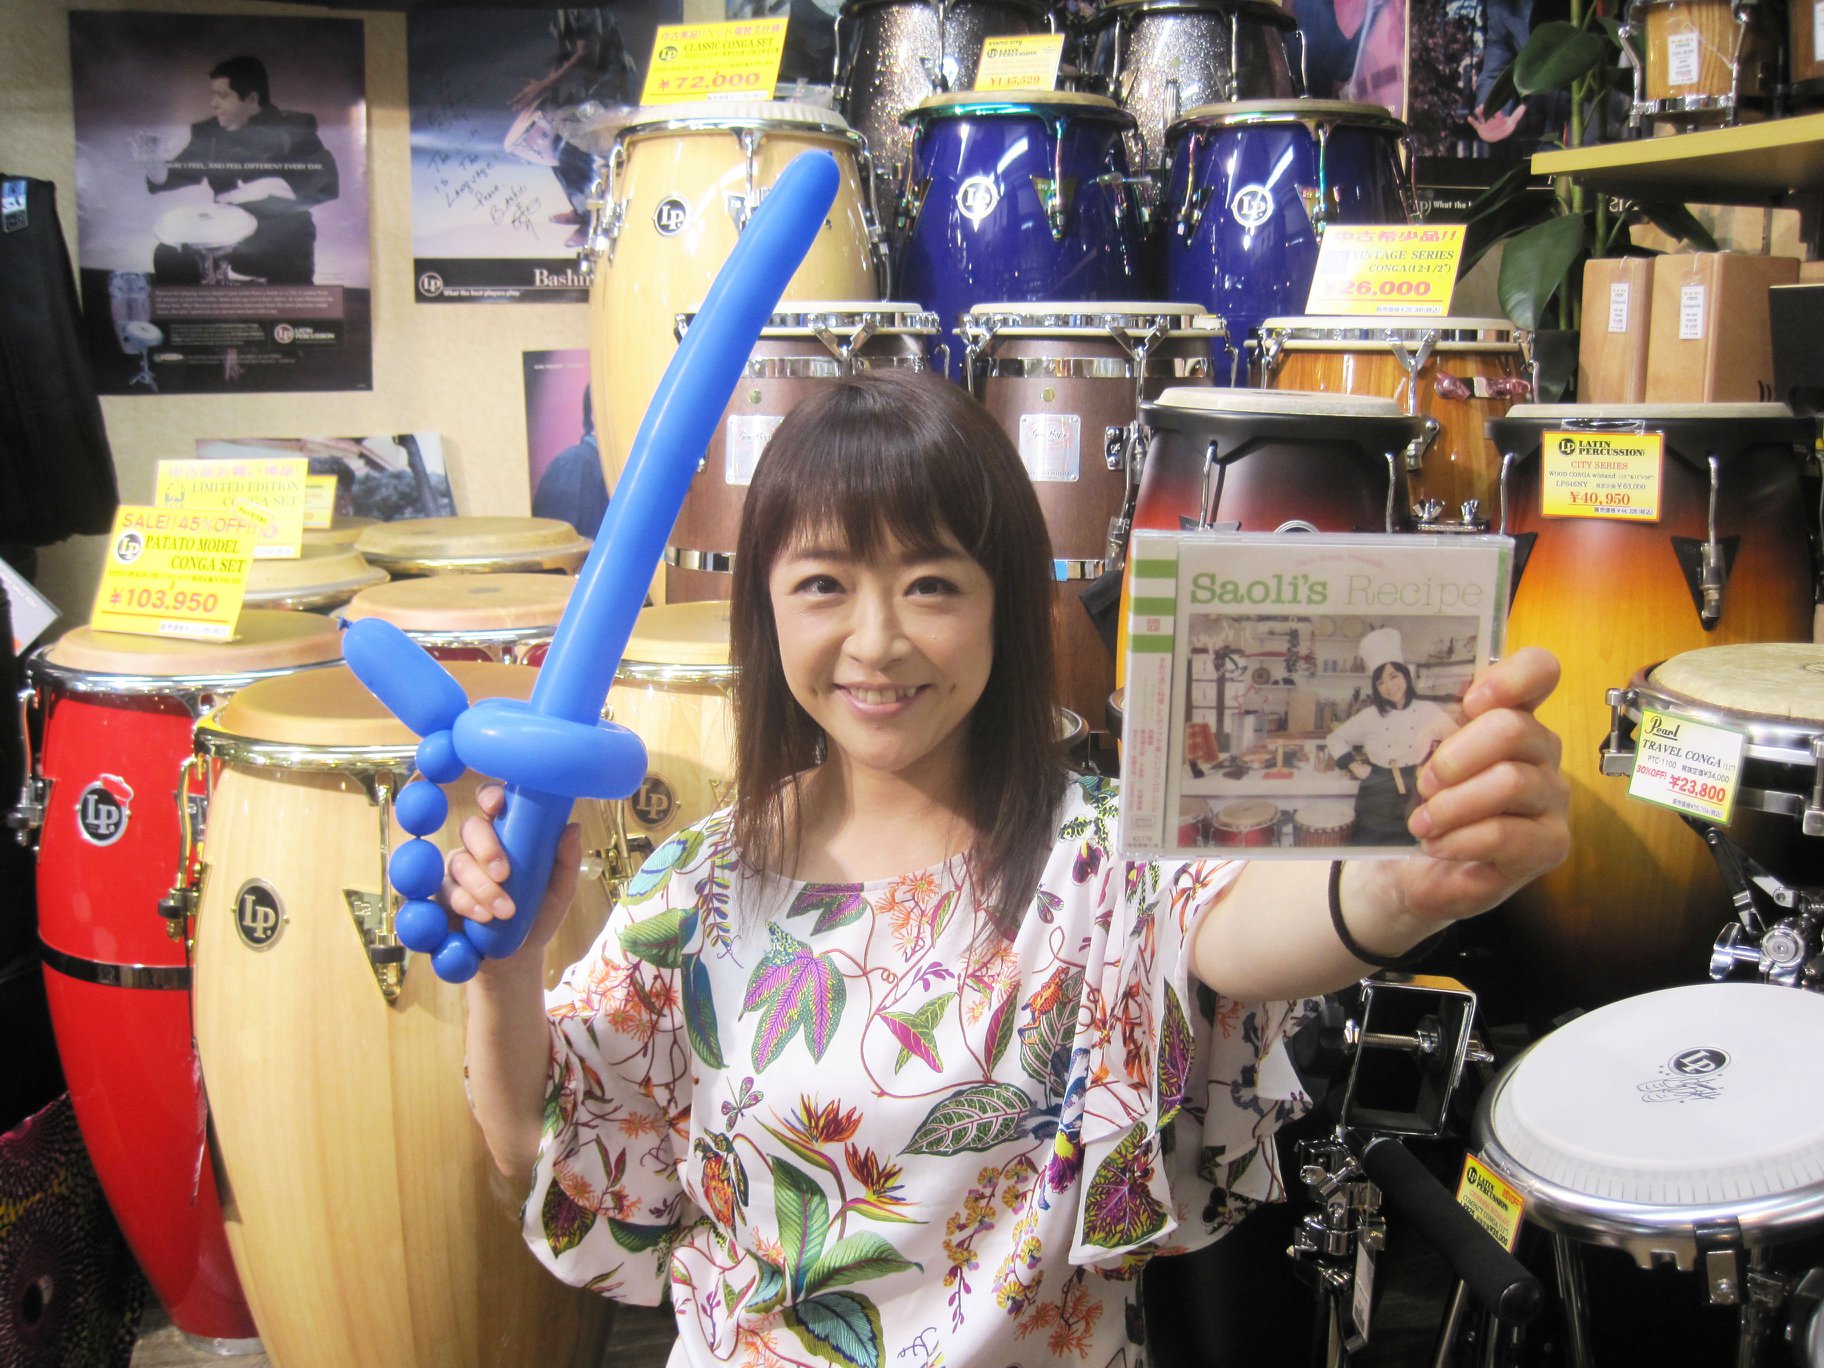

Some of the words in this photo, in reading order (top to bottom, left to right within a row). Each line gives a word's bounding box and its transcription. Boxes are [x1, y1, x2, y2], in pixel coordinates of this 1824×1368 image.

[683, 40, 721, 53] CLASSIC
[722, 39, 754, 50] CONGA
[755, 37, 774, 47] SET
[226, 162, 242, 170] FEEL
[243, 162, 283, 171] DIFFERENT
[284, 163, 307, 171] EVERY
[1433, 200, 1452, 209] What
[1454, 200, 1467, 209] the
[1352, 250, 1407, 260] VINTAGE
[1410, 250, 1454, 260] SERIES
[1578, 440, 1612, 449] LATIN
[1578, 448, 1644, 457] PERCUSSION
[1571, 460, 1593, 469] CITY
[1594, 461, 1629, 471] SERIES
[1548, 470, 1568, 478] WOOD
[1568, 471, 1591, 479] CONGA
[192, 481, 244, 493] LIMITED
[248, 480, 299, 493] EDITION
[273, 496, 298, 507] SET
[1569, 491, 1631, 506] ¥40,950
[145, 535, 195, 550] PATATO
[197, 537, 239, 553] MODEL
[171, 556, 216, 570] CONGA
[219, 558, 247, 574] SET
[1189, 572, 1328, 606] Saoli's
[1344, 573, 1485, 615] Recipe
[1645, 716, 1681, 741] Pearl
[1642, 739, 1682, 758] TRAVEL
[1685, 750, 1721, 768] CONGA
[1635, 764, 1667, 780] 30%OFF!
[1668, 773, 1726, 803] ¥23,800
[637, 785, 669, 819] LP
[86, 794, 120, 835] LP
[241, 893, 276, 939] LP
[1679, 1049, 1717, 1074] LP
[1478, 1174, 1495, 1191] LATIN
[1476, 1181, 1509, 1212] PERCUSSION
